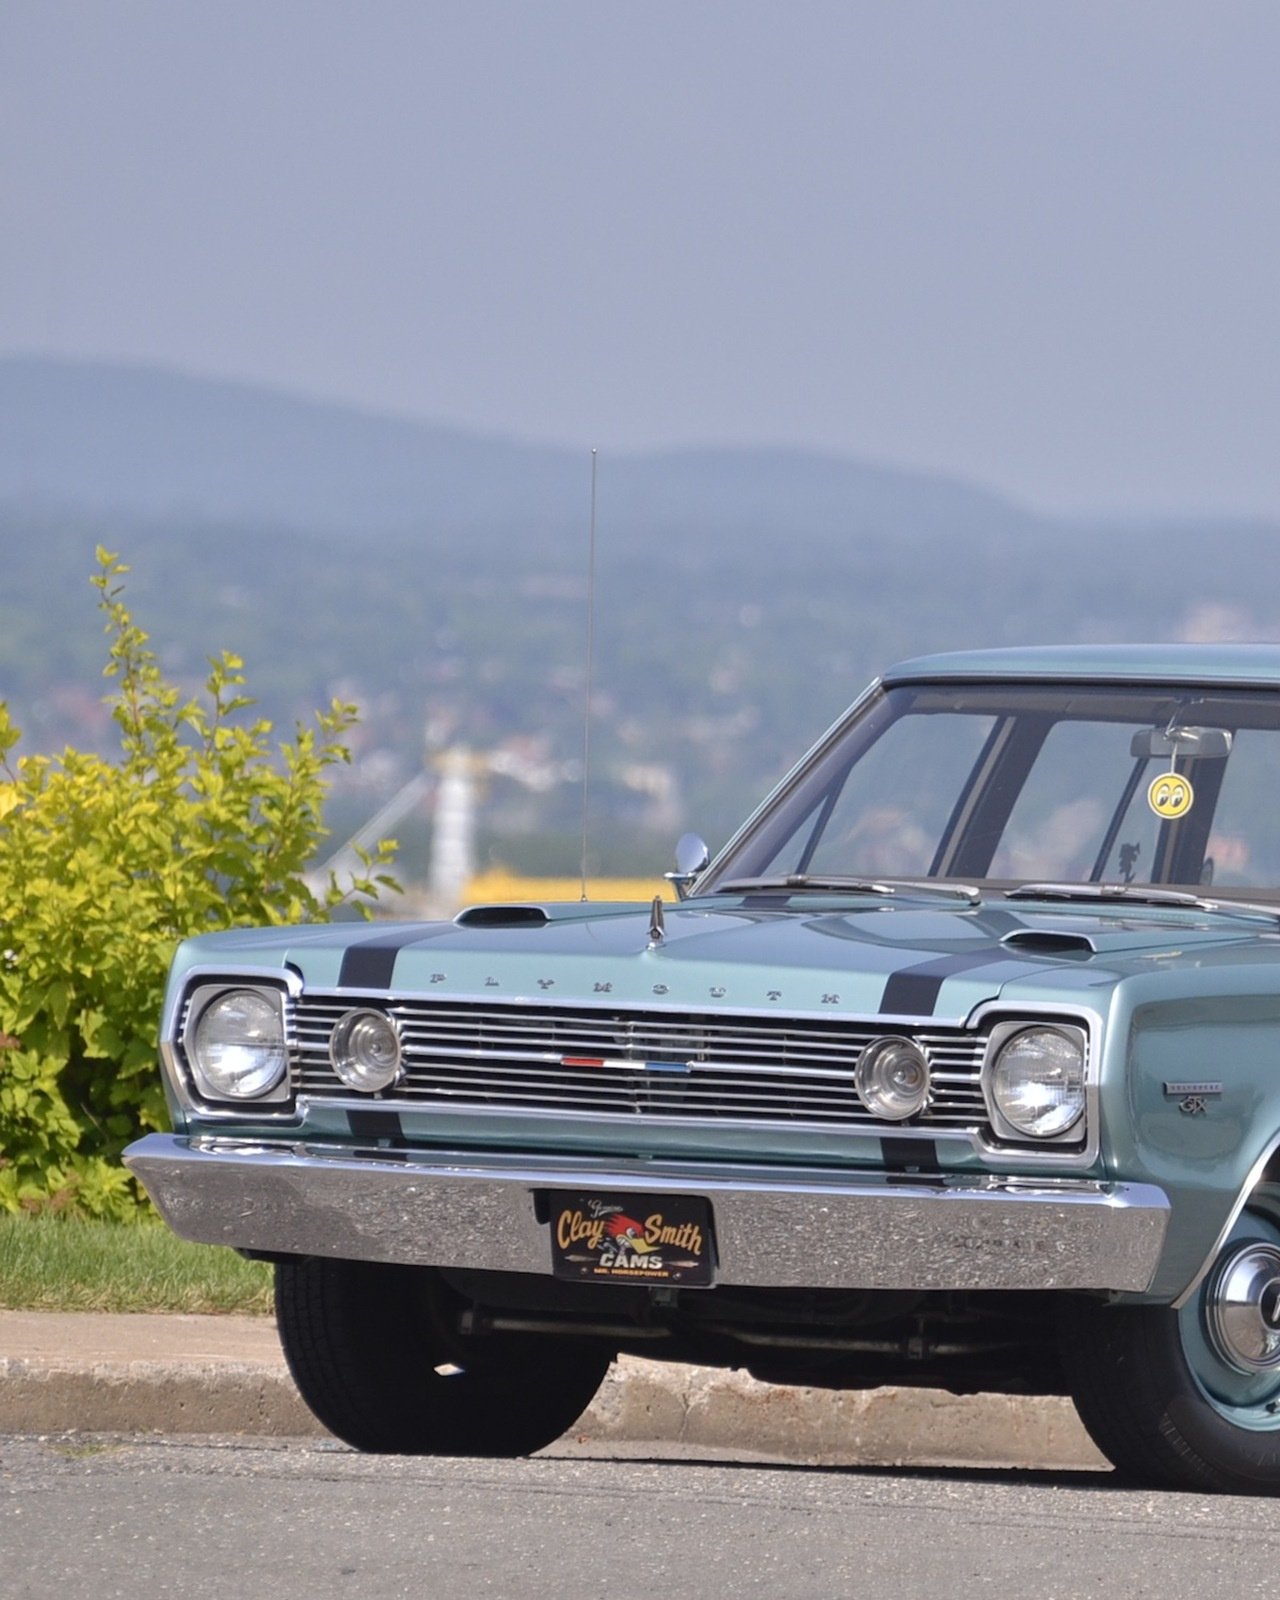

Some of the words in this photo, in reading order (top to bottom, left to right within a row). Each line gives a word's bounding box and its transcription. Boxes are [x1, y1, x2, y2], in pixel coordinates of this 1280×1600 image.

[429, 972, 841, 1005] PLYMOUTH
[1179, 1096, 1208, 1114] GTX
[558, 1210, 606, 1249] Clay
[645, 1214, 702, 1255] Smith
[599, 1253, 663, 1269] CAMS
[611, 1268, 670, 1278] HORSEPOWER
